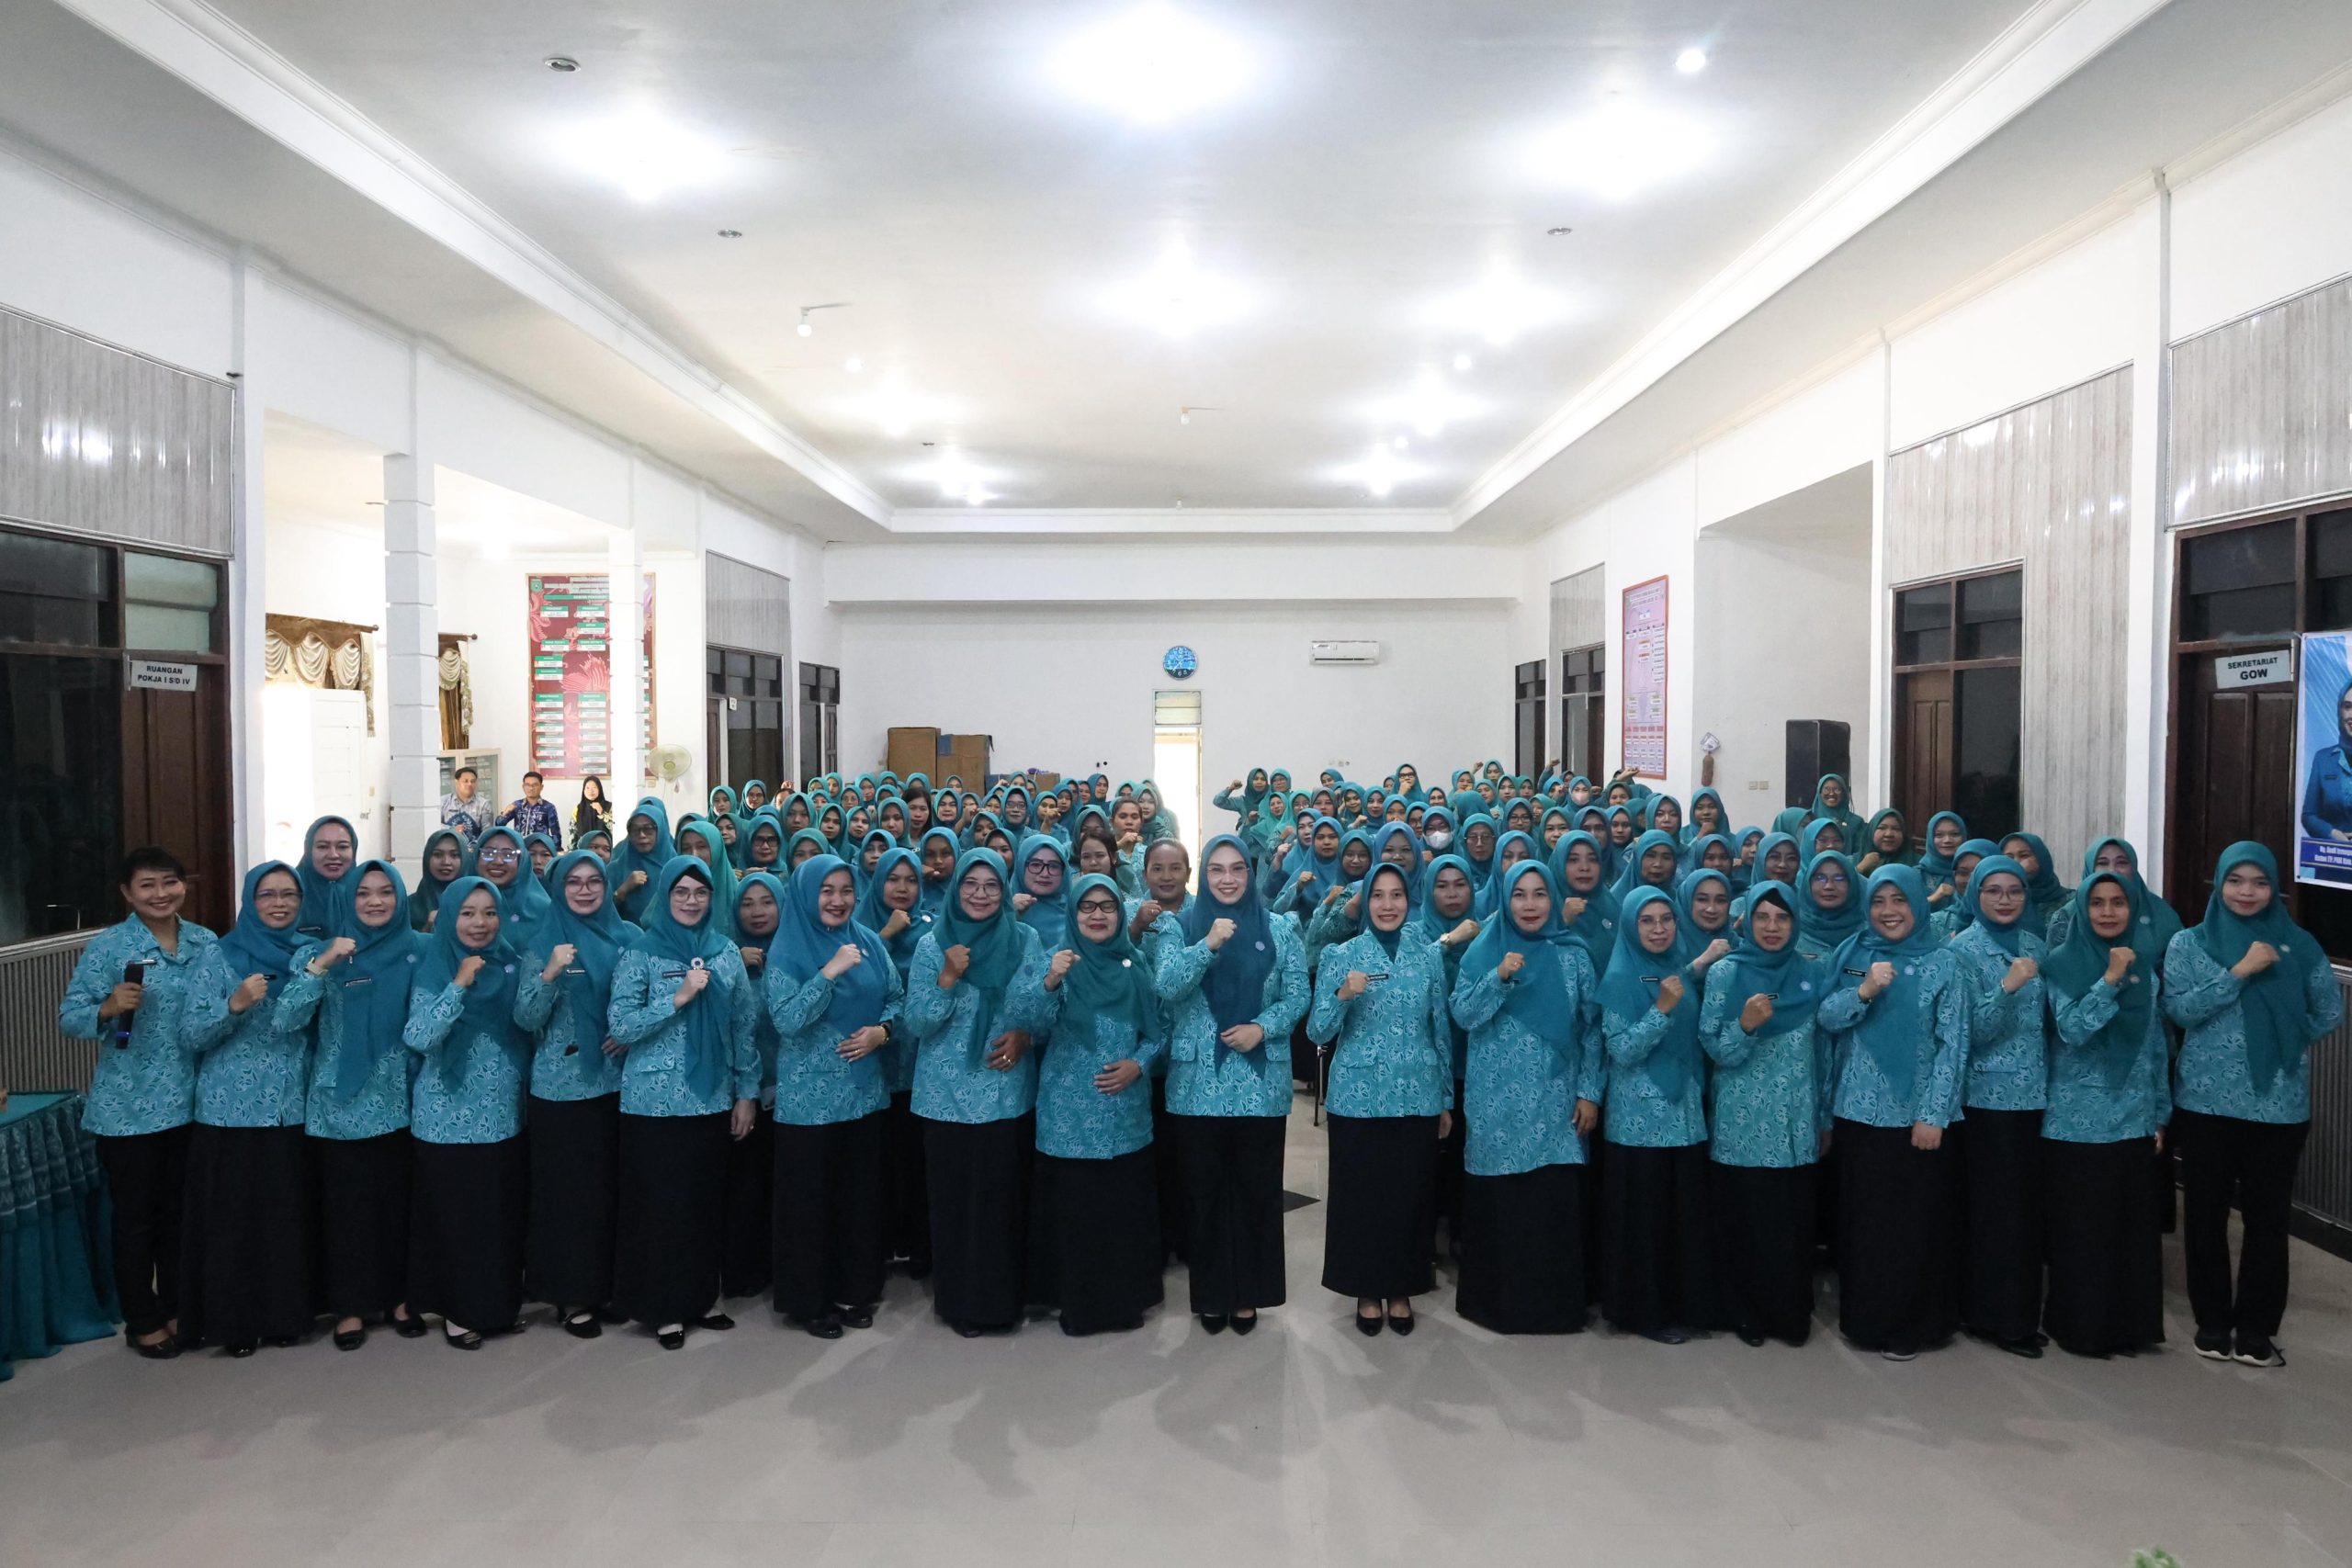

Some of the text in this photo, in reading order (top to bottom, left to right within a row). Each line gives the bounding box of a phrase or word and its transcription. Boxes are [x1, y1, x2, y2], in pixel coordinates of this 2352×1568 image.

[2228, 657, 2278, 670] SEKRETARIAT
[146, 665, 183, 674] RUANGAN
[2240, 669, 2267, 680] GOW
[138, 674, 162, 682] POKJA
